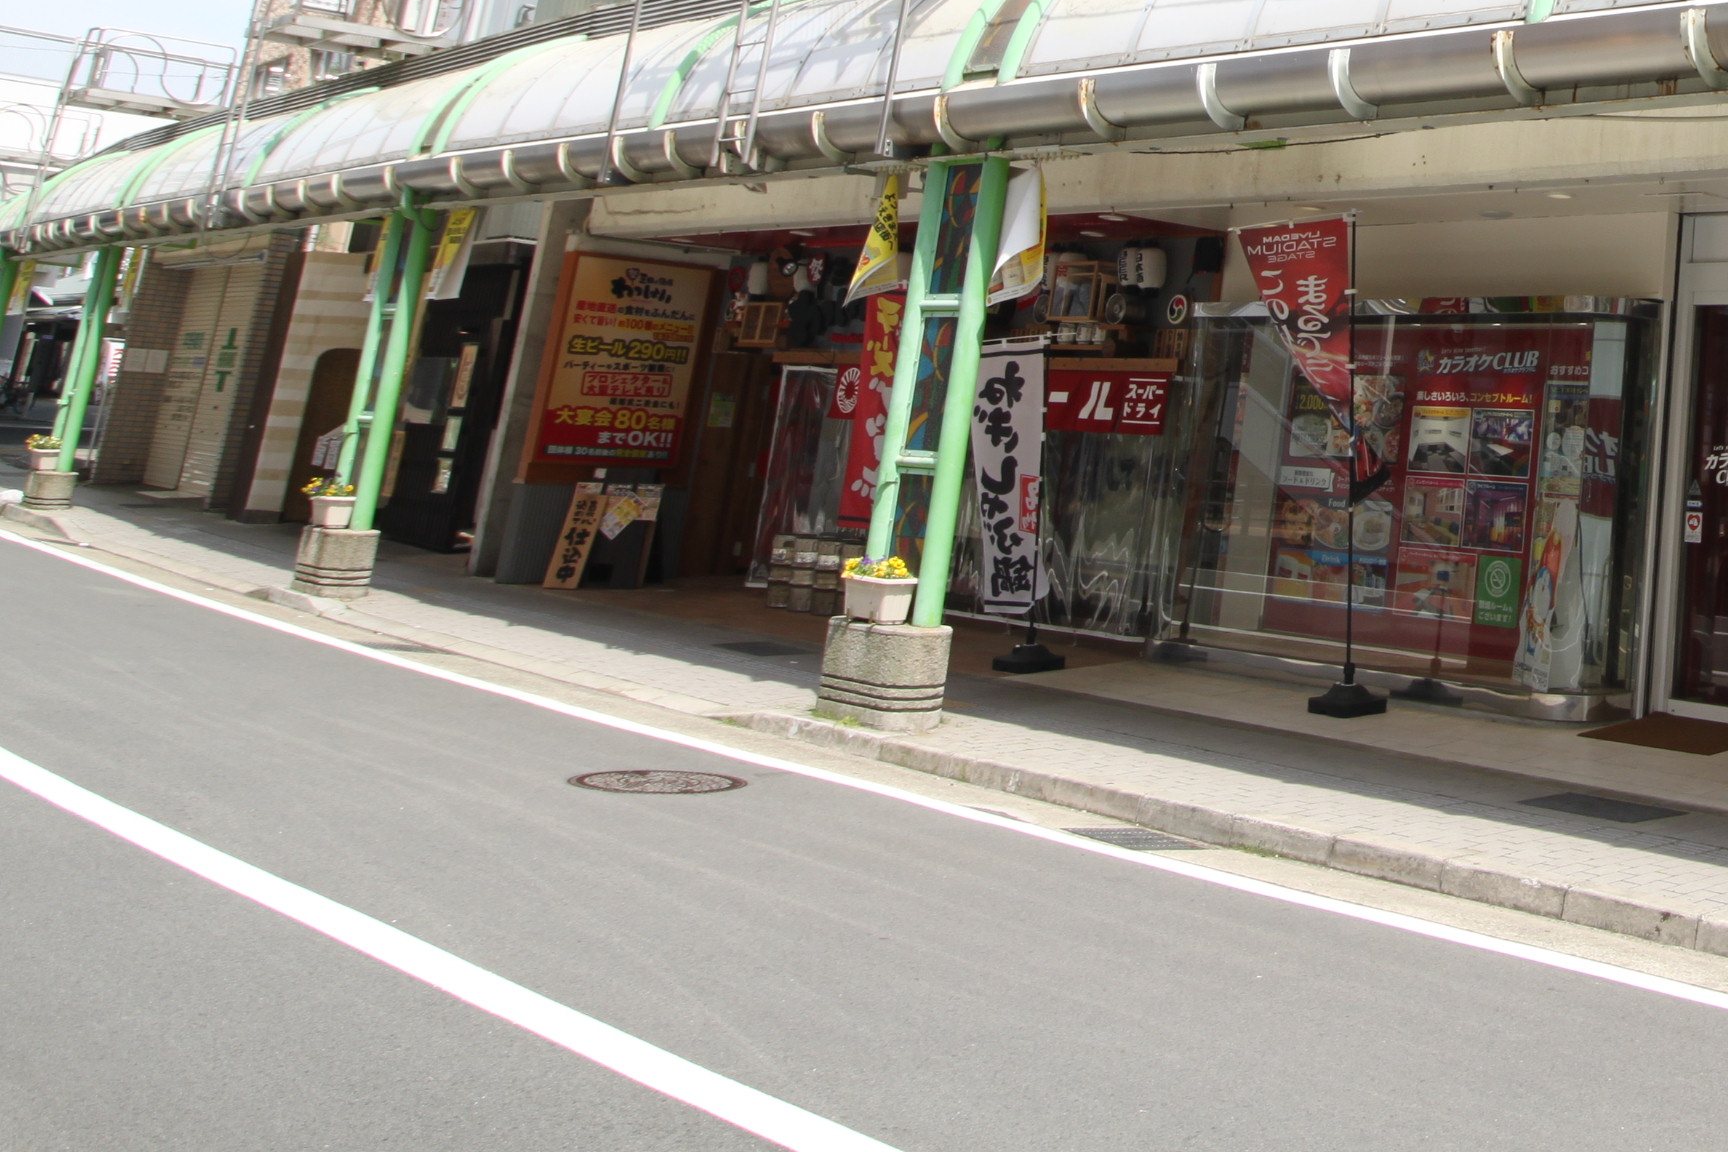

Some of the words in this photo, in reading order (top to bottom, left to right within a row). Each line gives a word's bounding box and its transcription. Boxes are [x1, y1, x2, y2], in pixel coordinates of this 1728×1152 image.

[569, 337, 626, 356] 生ビール
[628, 341, 688, 361] 290円!!
[1436, 350, 1540, 375] カラオケCLUB
[1125, 384, 1164, 400] スーパー
[554, 408, 677, 430] 大宴会80名様
[1122, 402, 1162, 419] ドライ
[597, 431, 673, 447] までOK!!
[1328, 498, 1346, 508] Food
